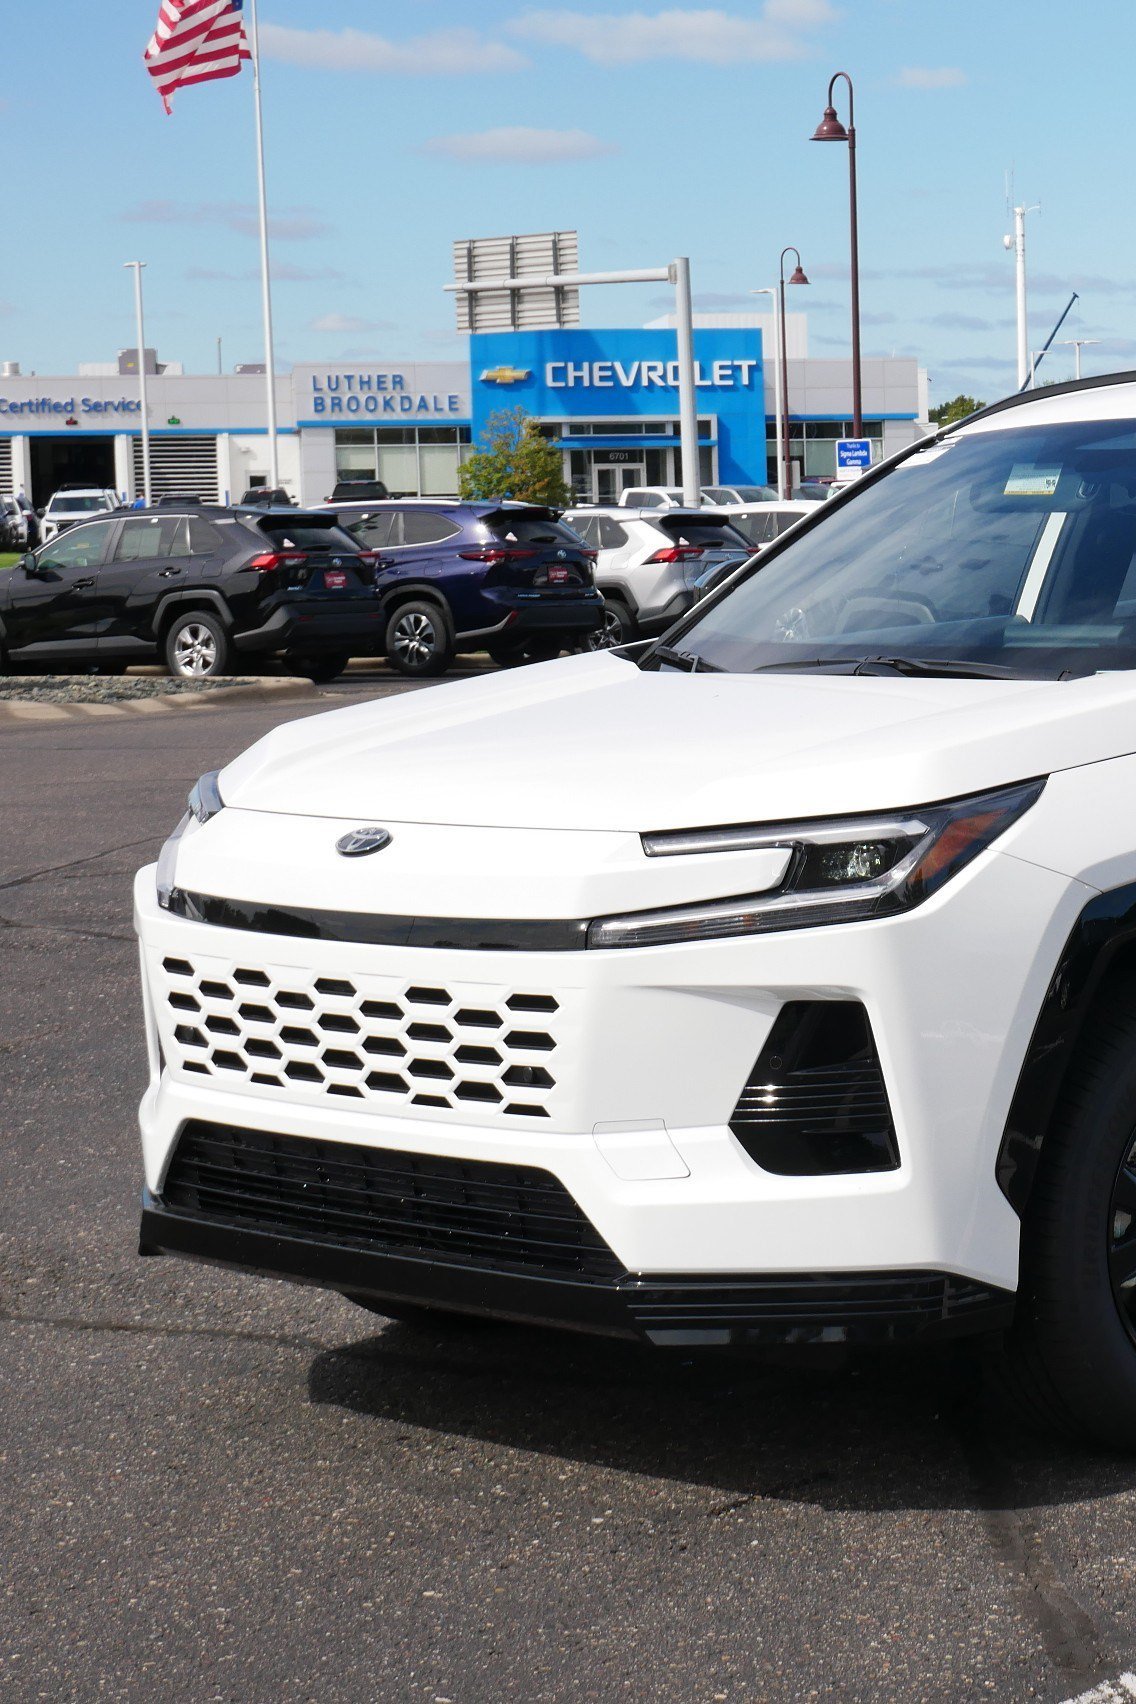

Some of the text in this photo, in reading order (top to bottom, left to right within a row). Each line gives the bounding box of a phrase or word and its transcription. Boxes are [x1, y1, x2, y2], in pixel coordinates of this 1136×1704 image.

[546, 360, 756, 387] CHEVROLET
[313, 375, 405, 391] LUTHER
[313, 395, 460, 413] BROOKDALE
[609, 452, 628, 460] 6701
